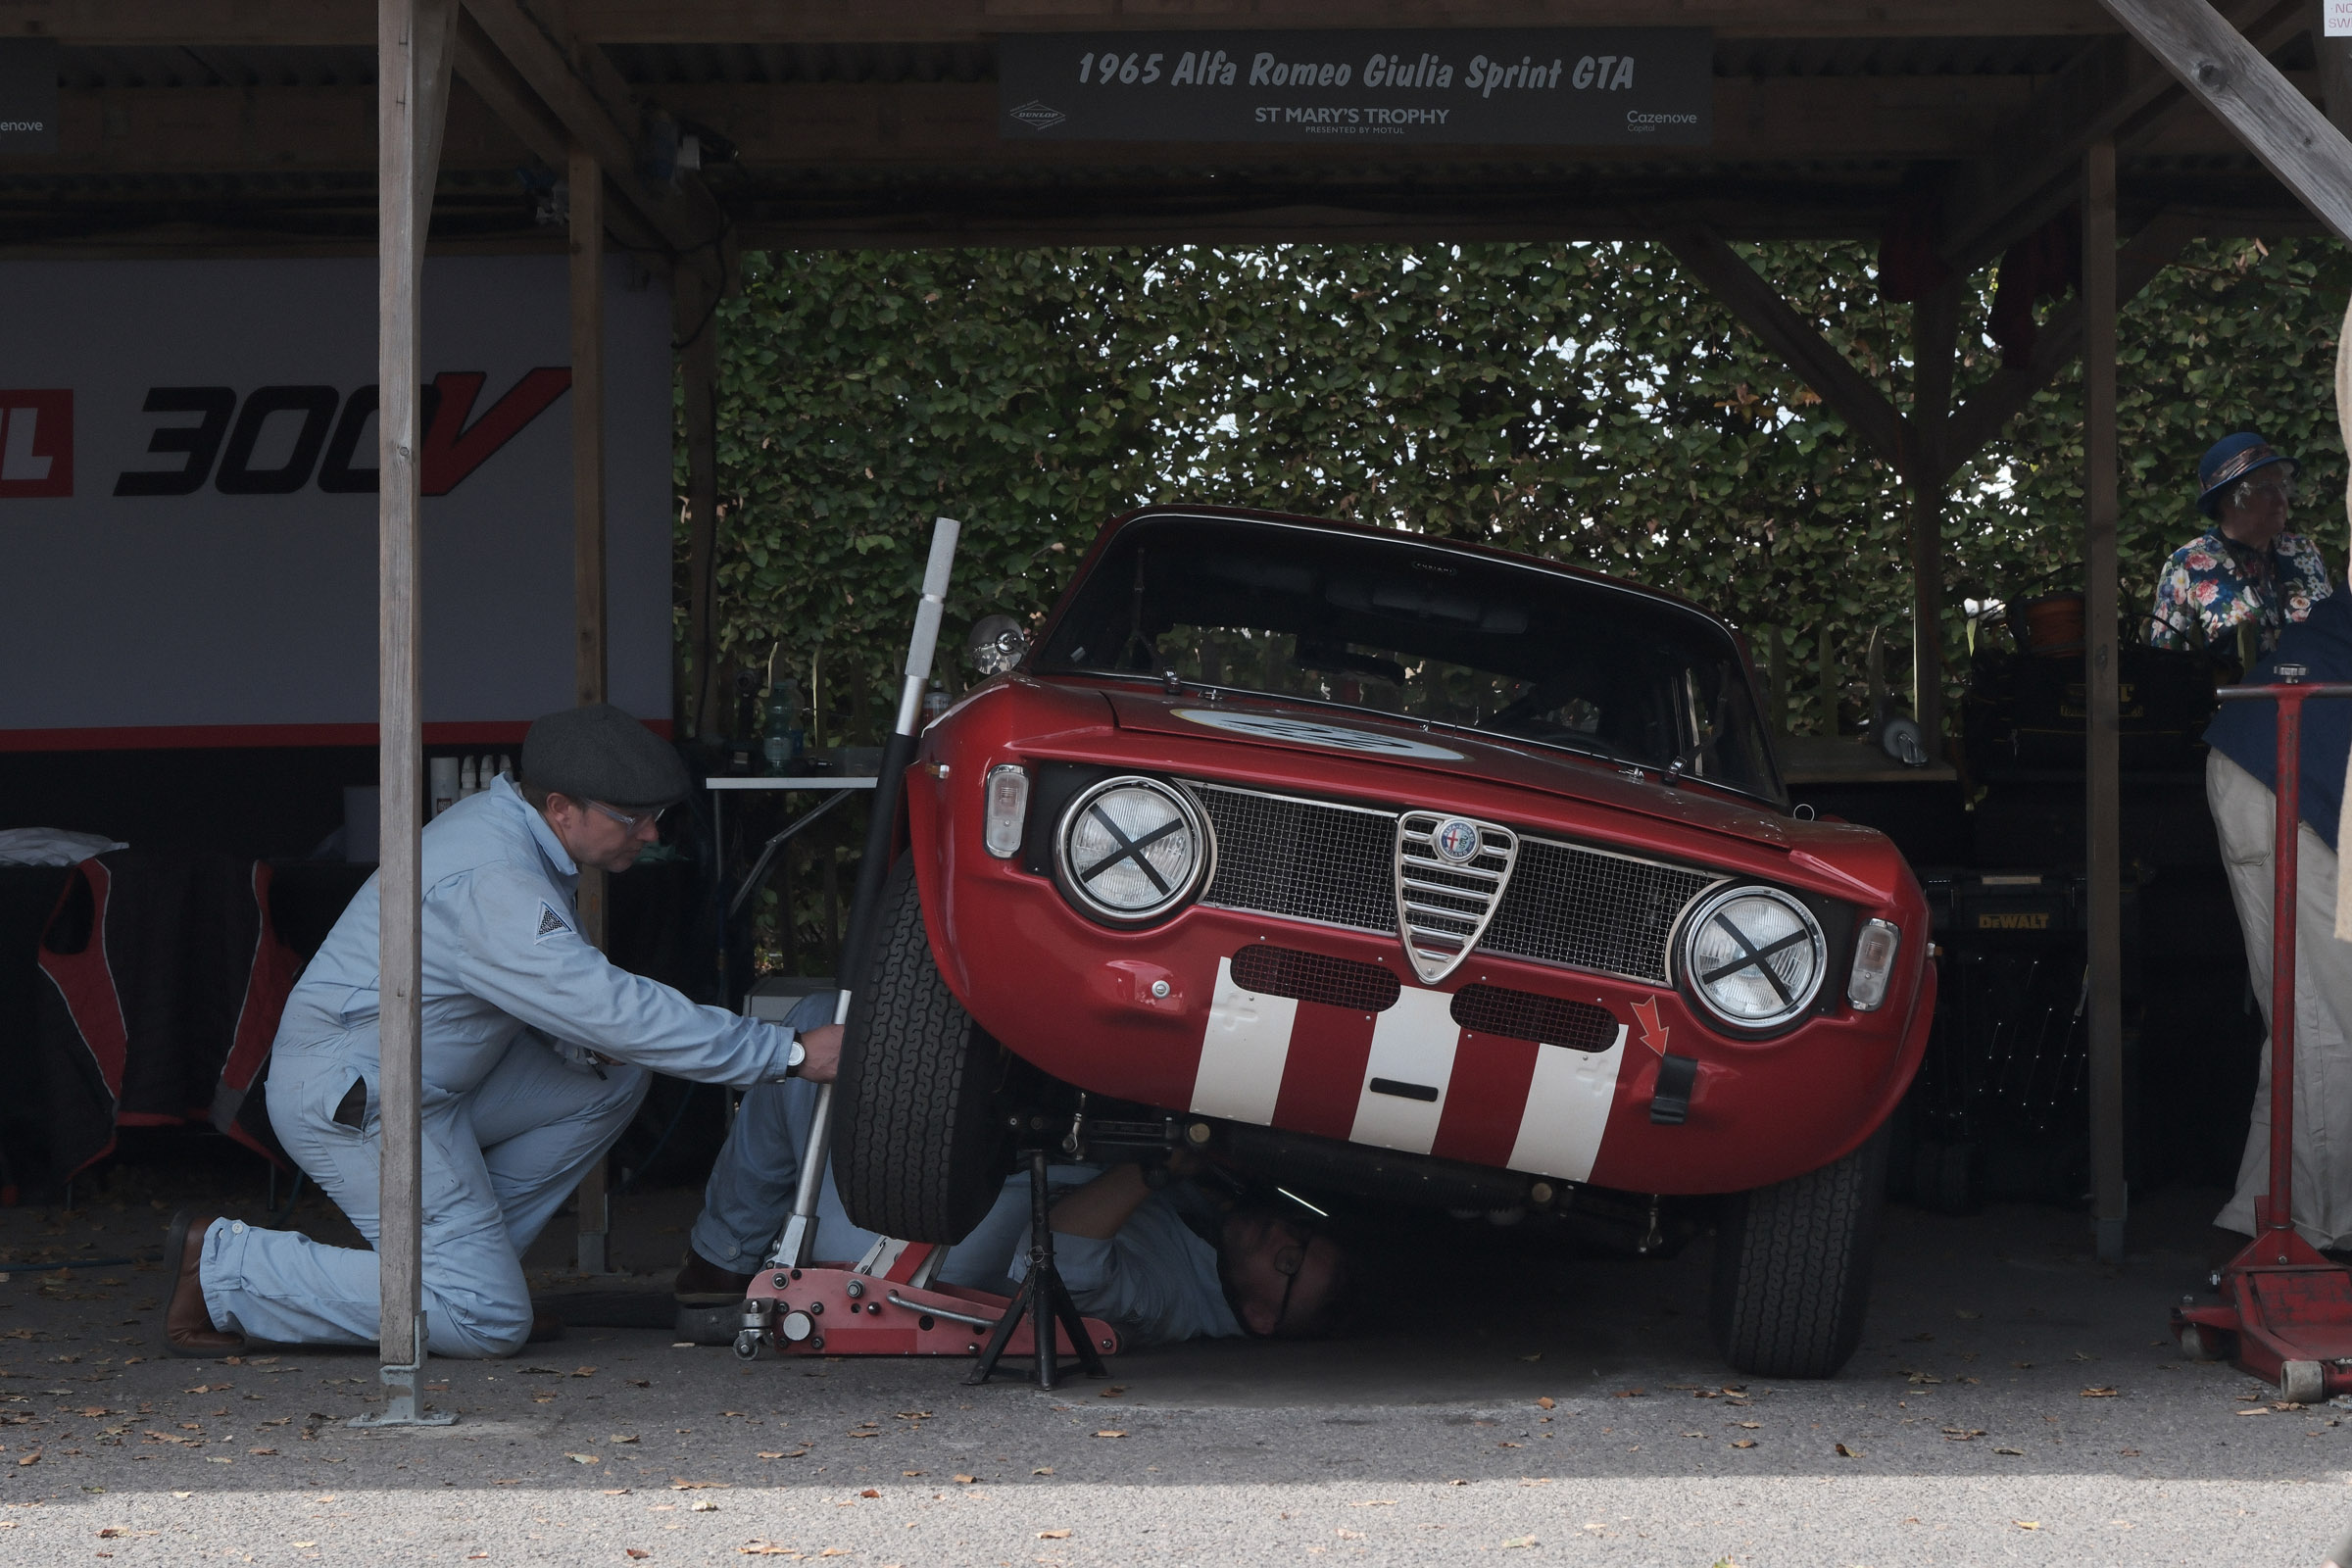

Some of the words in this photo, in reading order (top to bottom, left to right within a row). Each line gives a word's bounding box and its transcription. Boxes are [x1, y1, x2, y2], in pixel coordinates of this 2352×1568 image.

[1079, 52, 1163, 85] 1965
[1170, 50, 1238, 86] Alfa
[1249, 52, 1352, 86] Romeo
[1362, 53, 1454, 88] Giulia
[1464, 55, 1563, 98] Sprint
[1571, 55, 1636, 91] GTA
[1254, 107, 1282, 122] ST
[1286, 107, 1361, 123] MARY'S
[1363, 108, 1450, 124] TROPHY
[1626, 110, 1698, 123] Cazenove
[1304, 125, 1357, 134] PRESENTED
[1358, 125, 1371, 134] BY
[1627, 123, 1655, 133] Capital
